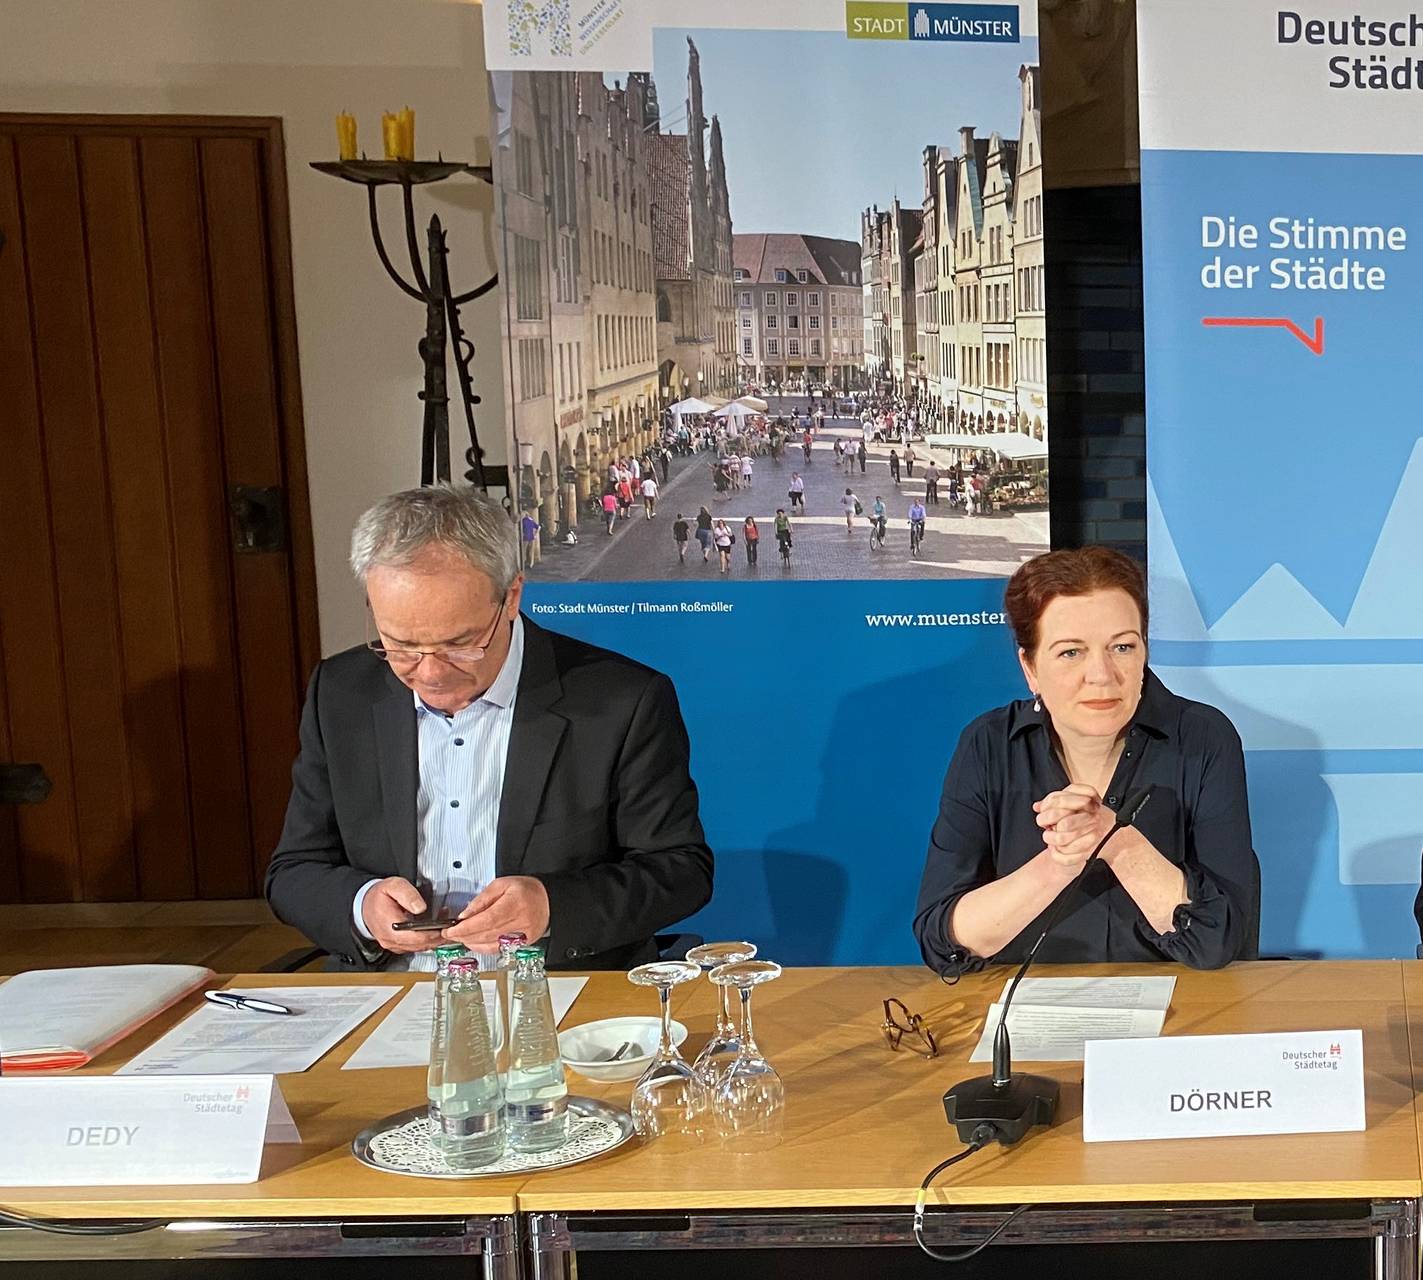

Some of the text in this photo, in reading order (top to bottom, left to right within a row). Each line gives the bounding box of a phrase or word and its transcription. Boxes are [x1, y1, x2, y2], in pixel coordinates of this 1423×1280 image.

[853, 16, 1013, 36] STADT MÜNSTER
[1201, 216, 1407, 251] Die Stimme
[1201, 256, 1387, 290] der Städte
[532, 603, 557, 614] Foto:
[558, 603, 585, 614] Stadt
[587, 603, 630, 614] Münster
[637, 602, 679, 613] Tilmann
[680, 602, 734, 613] Roßmöller
[865, 611, 1007, 626] www.muenster
[1282, 1049, 1327, 1061] Deutscher
[1294, 1060, 1338, 1071] Städtetag
[183, 1092, 234, 1103] Deutscher
[1170, 1089, 1273, 1113] DÖRNER
[194, 1103, 243, 1114] Städtetag
[65, 1126, 140, 1147] DEDY
